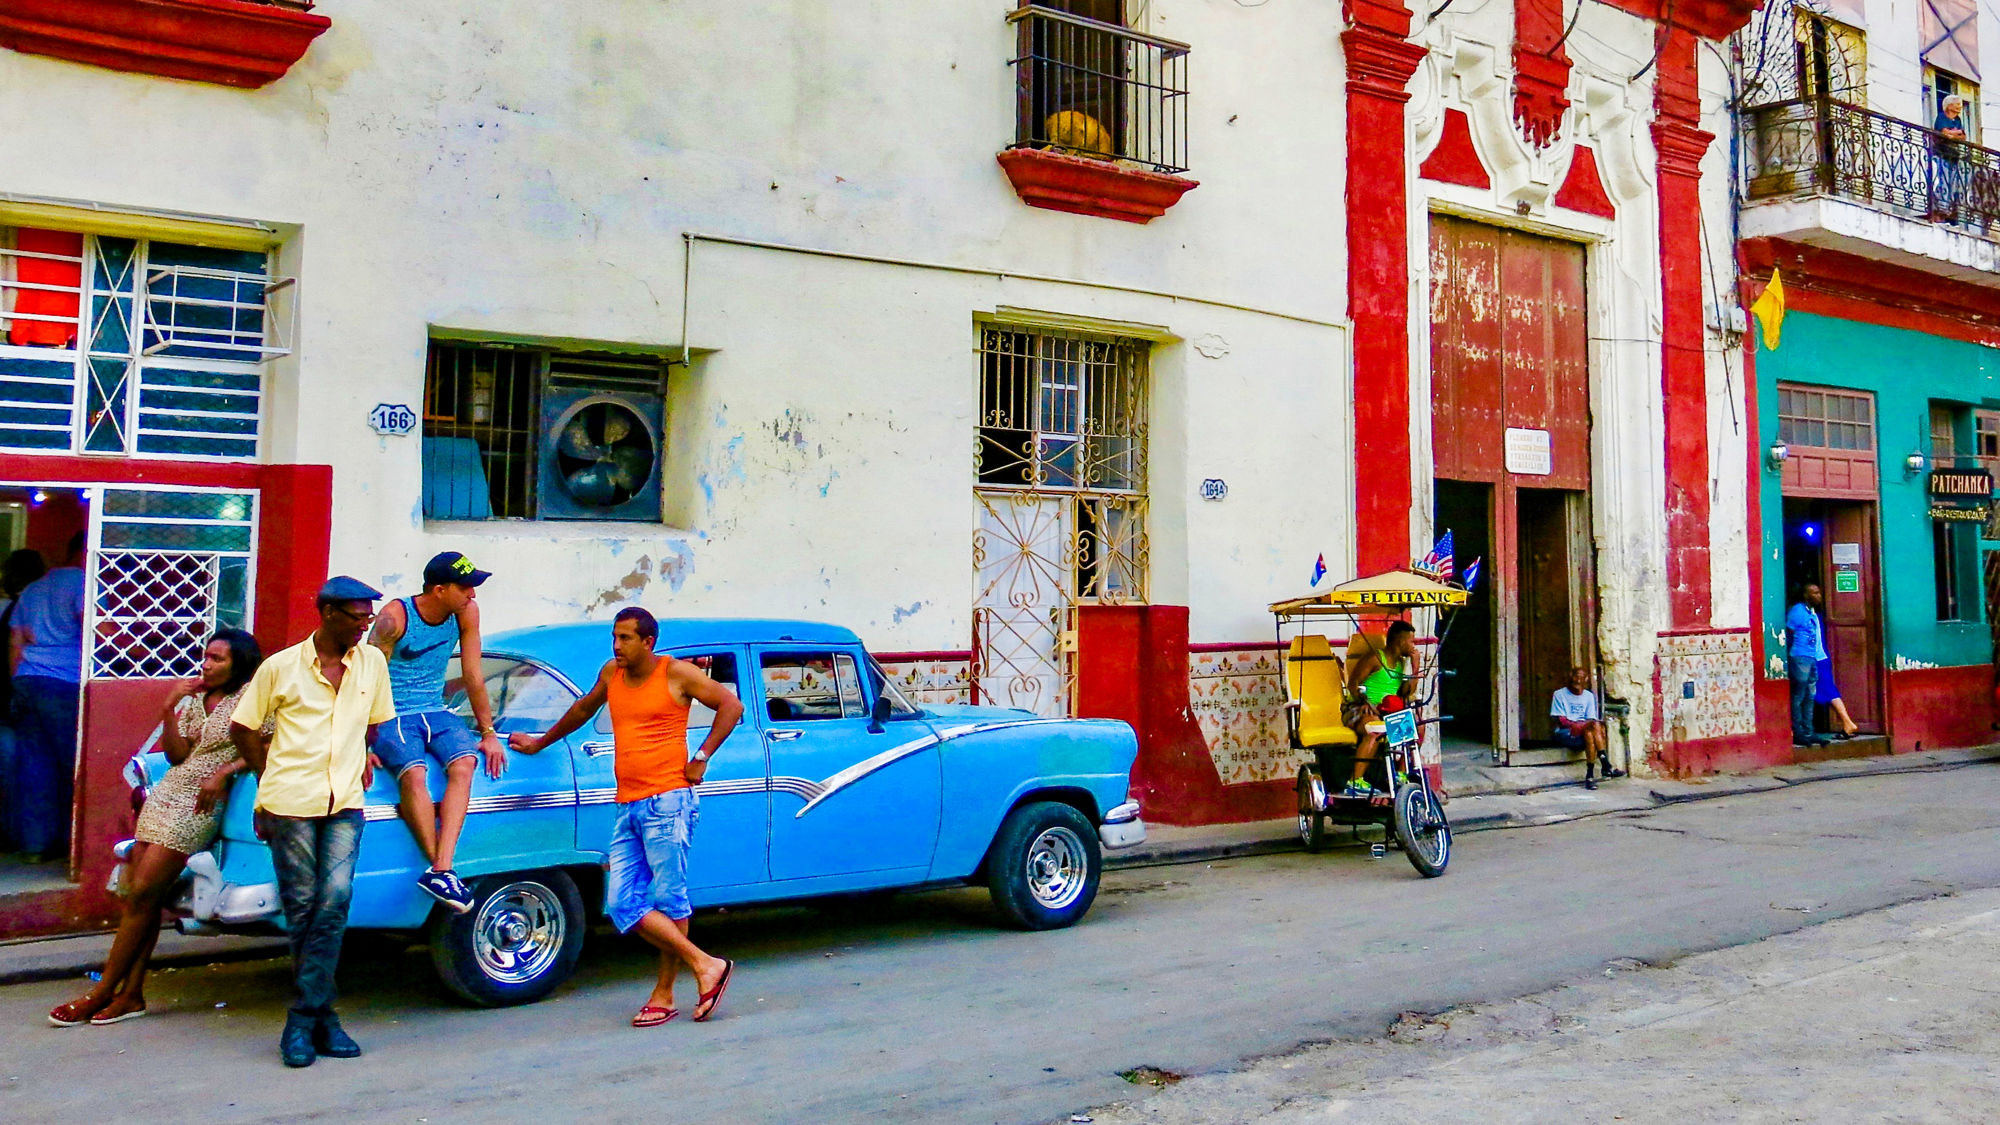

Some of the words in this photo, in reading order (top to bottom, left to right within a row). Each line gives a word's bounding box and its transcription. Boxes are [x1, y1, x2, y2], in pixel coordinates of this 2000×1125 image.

[379, 410, 409, 429] 166
[1206, 483, 1225, 496] 164A
[1931, 474, 1990, 494] PATCHANKA
[1414, 560, 1439, 574] TAXI
[1360, 592, 1380, 603] EL
[1386, 591, 1451, 603] TITANIC
